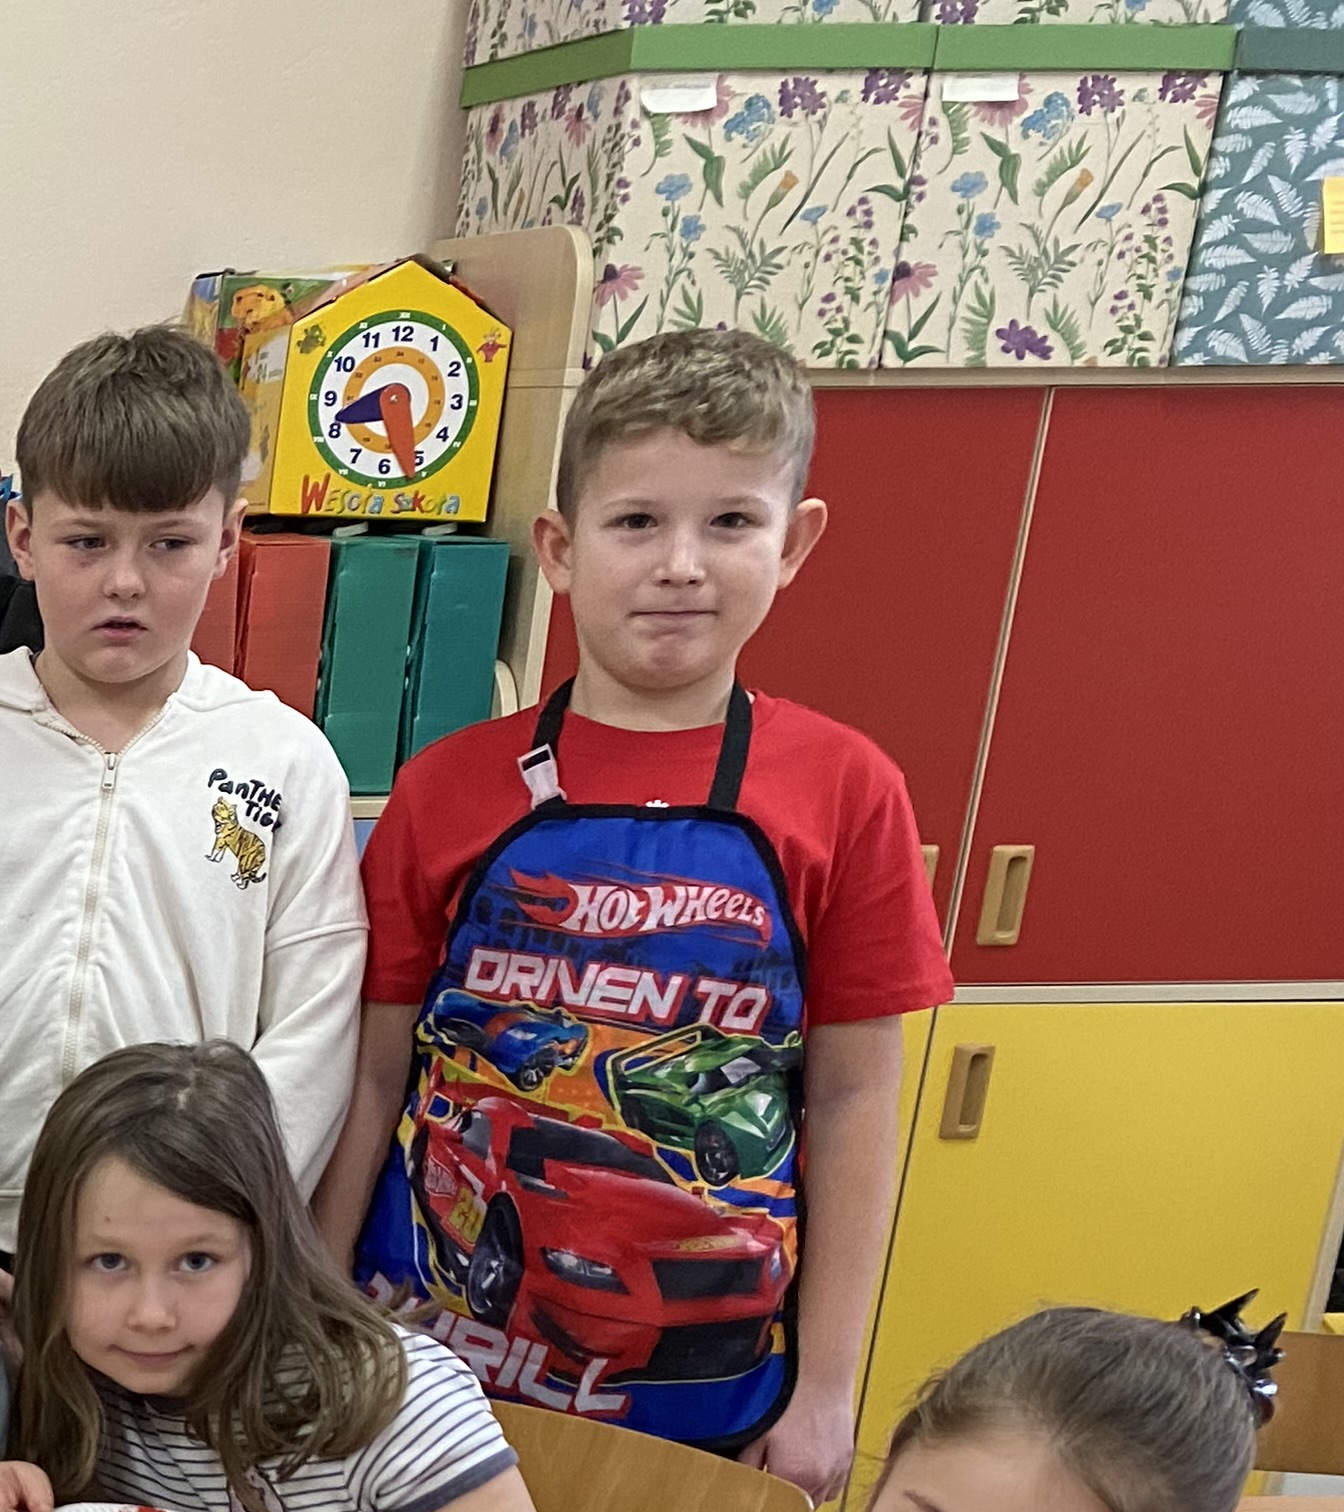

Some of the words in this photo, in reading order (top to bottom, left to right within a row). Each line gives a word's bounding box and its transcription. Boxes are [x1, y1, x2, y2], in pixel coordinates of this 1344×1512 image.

[362, 332, 381, 348] 11
[392, 326, 414, 342] 12
[430, 336, 439, 352] 1
[334, 356, 356, 373] 10
[447, 361, 462, 378] 2
[324, 391, 338, 407] 9
[450, 394, 464, 410] 3
[328, 422, 342, 439] 8
[436, 426, 449, 443] 4
[349, 448, 362, 464] 7
[414, 450, 425, 466] 5
[378, 459, 391, 474] 6
[464, 948, 683, 1018] DRIVEN
[695, 979, 769, 1031] TO
[367, 1270, 628, 1413] RILL
